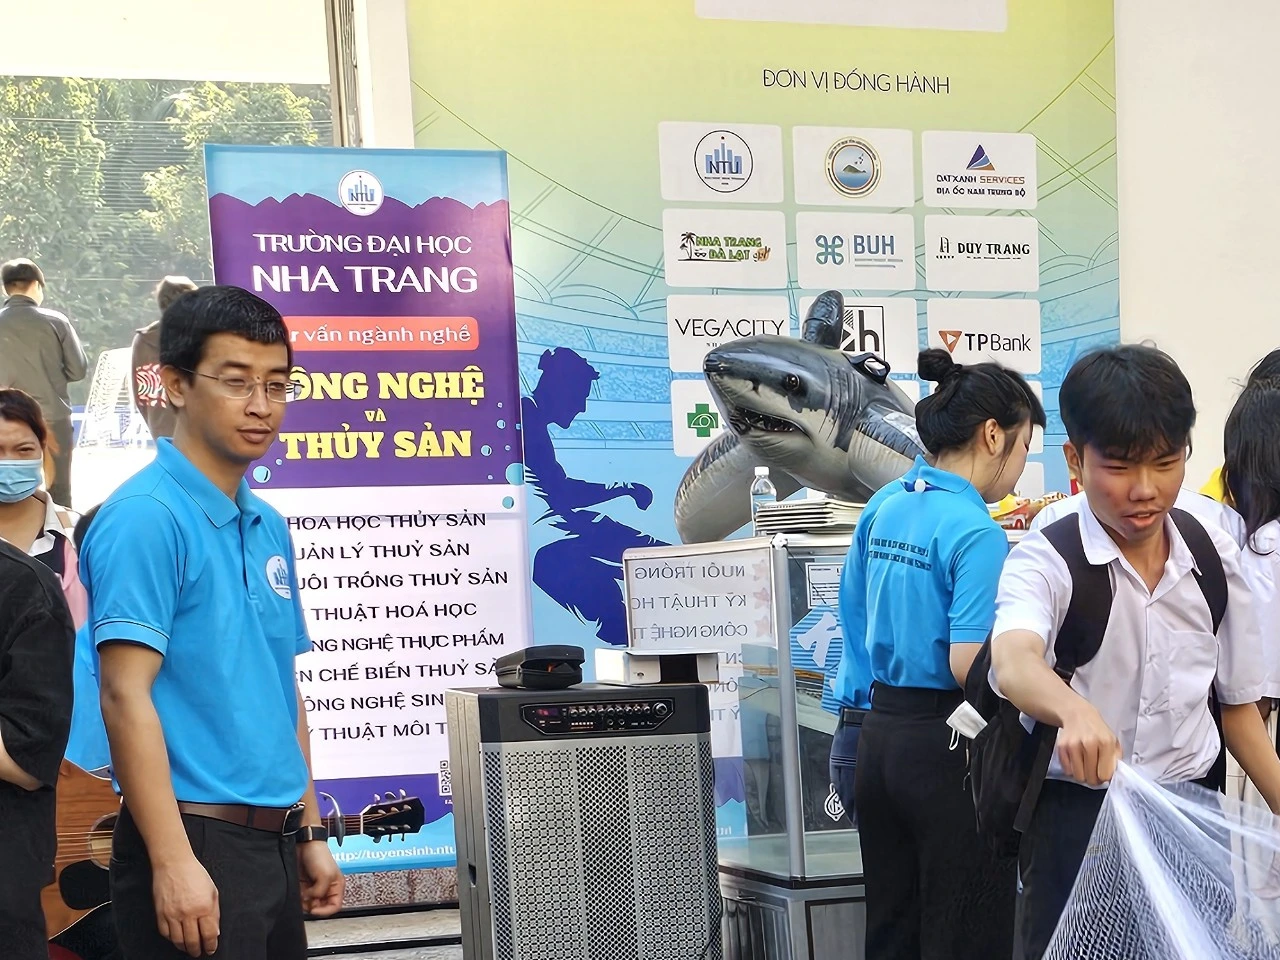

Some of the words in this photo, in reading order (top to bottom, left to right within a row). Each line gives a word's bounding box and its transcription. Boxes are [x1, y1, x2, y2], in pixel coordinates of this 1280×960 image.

[763, 69, 806, 88] ĐƠN
[811, 70, 828, 93] VỊ
[896, 71, 950, 94] HÀNH
[709, 160, 739, 175] NTU
[979, 175, 1025, 185] SERVICES
[350, 192, 375, 202] NTU
[252, 228, 362, 253] TRƯỜNG
[366, 235, 411, 257] ĐẠI
[416, 235, 472, 257] HỌC
[853, 234, 895, 255] BUH
[957, 242, 982, 254] DUY
[986, 243, 1030, 255] TRANG
[252, 264, 339, 293] NHA
[344, 265, 479, 294] TRANG
[303, 322, 342, 343] vấn
[348, 325, 414, 345] ngành
[674, 318, 785, 337] VEGACITY
[964, 334, 1032, 352] TPBank
[288, 366, 370, 400] ÔNG
[377, 365, 485, 406] NGHỆ
[278, 422, 385, 460] THỦY
[393, 421, 472, 458] SẢN
[288, 516, 331, 531] HOA
[337, 515, 381, 531] HỌC
[446, 508, 487, 527] SẢN
[295, 542, 334, 561] UẢN
[340, 541, 364, 560] LÝ
[429, 538, 470, 557] SẢN
[298, 573, 328, 590] UÔI
[467, 566, 508, 586] SẢN
[310, 602, 381, 623] THUẬT
[385, 600, 430, 620] HOÁ
[434, 602, 478, 619] HỌC
[342, 633, 394, 652] NGHỆ
[318, 661, 360, 682] CHẾ
[365, 660, 411, 680] BIẾN
[475, 657, 497, 675] SẢ
[304, 695, 345, 712] ÔNG
[351, 692, 407, 710] NGHỆ
[411, 693, 444, 707] SIN
[318, 722, 388, 741] THUẬT
[393, 720, 431, 738] MÔI
